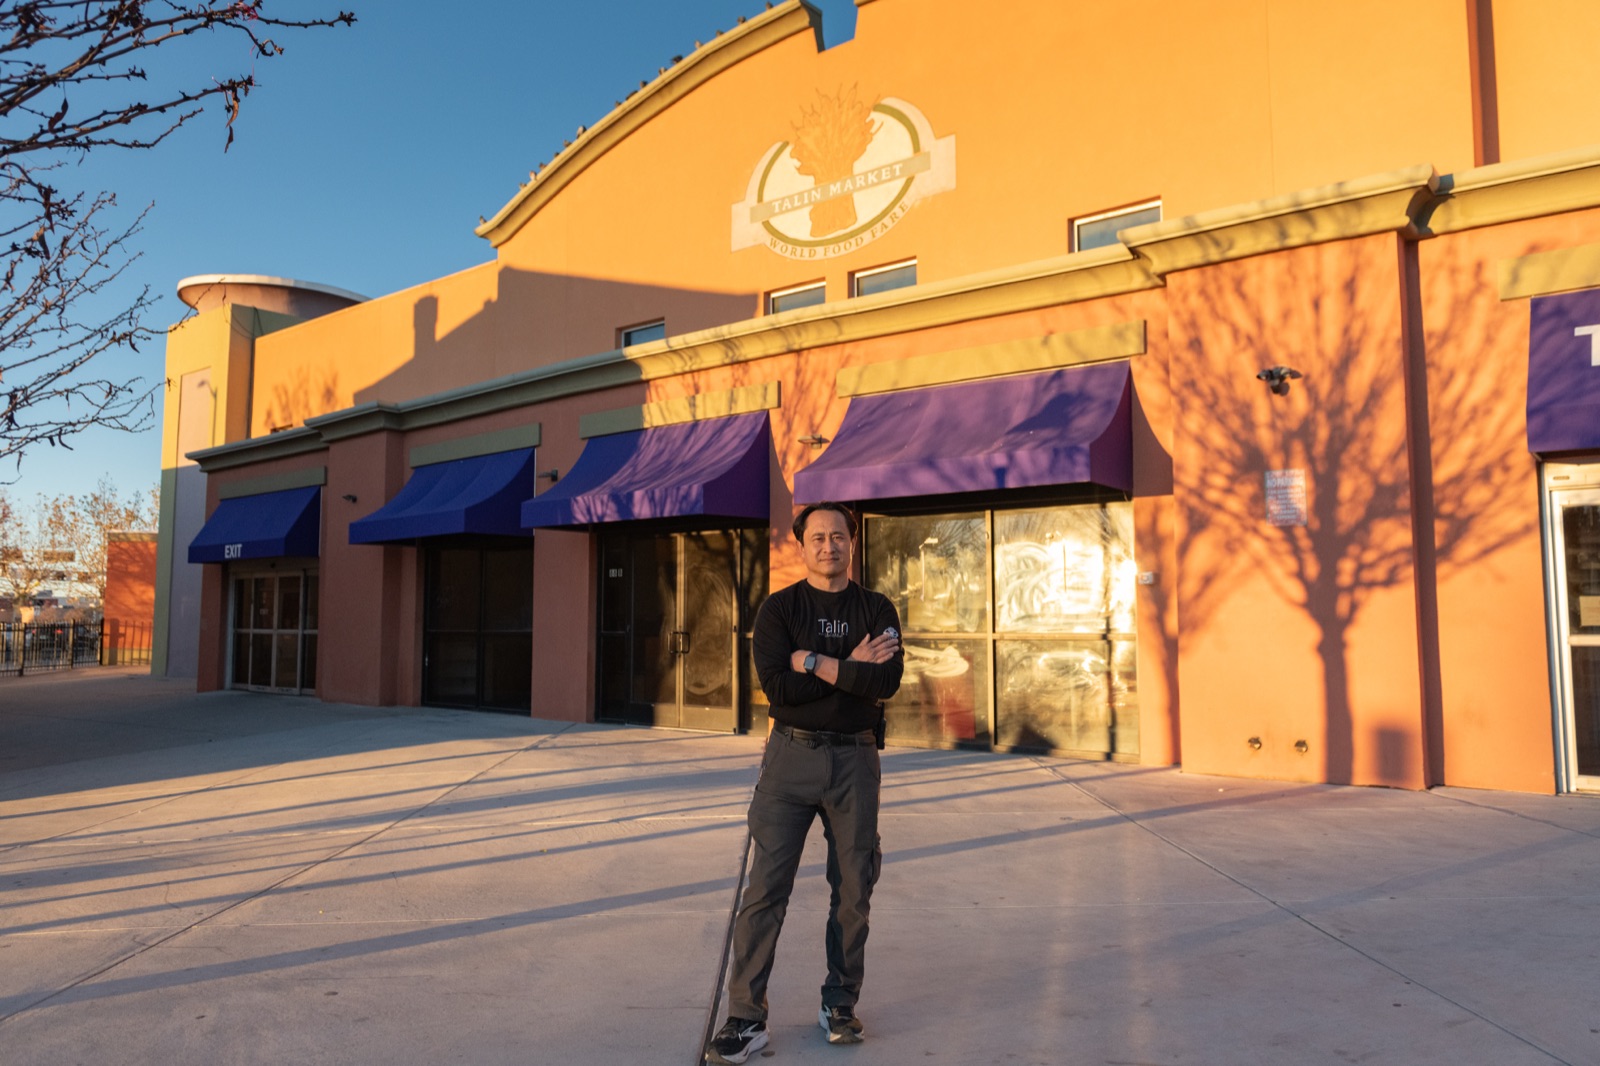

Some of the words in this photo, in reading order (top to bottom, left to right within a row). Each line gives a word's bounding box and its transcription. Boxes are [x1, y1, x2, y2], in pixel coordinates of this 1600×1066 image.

[771, 188, 822, 213] TALIN
[829, 163, 904, 196] MARKET
[768, 237, 817, 258] WORLD
[823, 236, 864, 257] FOOD
[870, 201, 909, 239] FARE
[224, 544, 243, 559] EXIT
[818, 618, 849, 634] Talin
